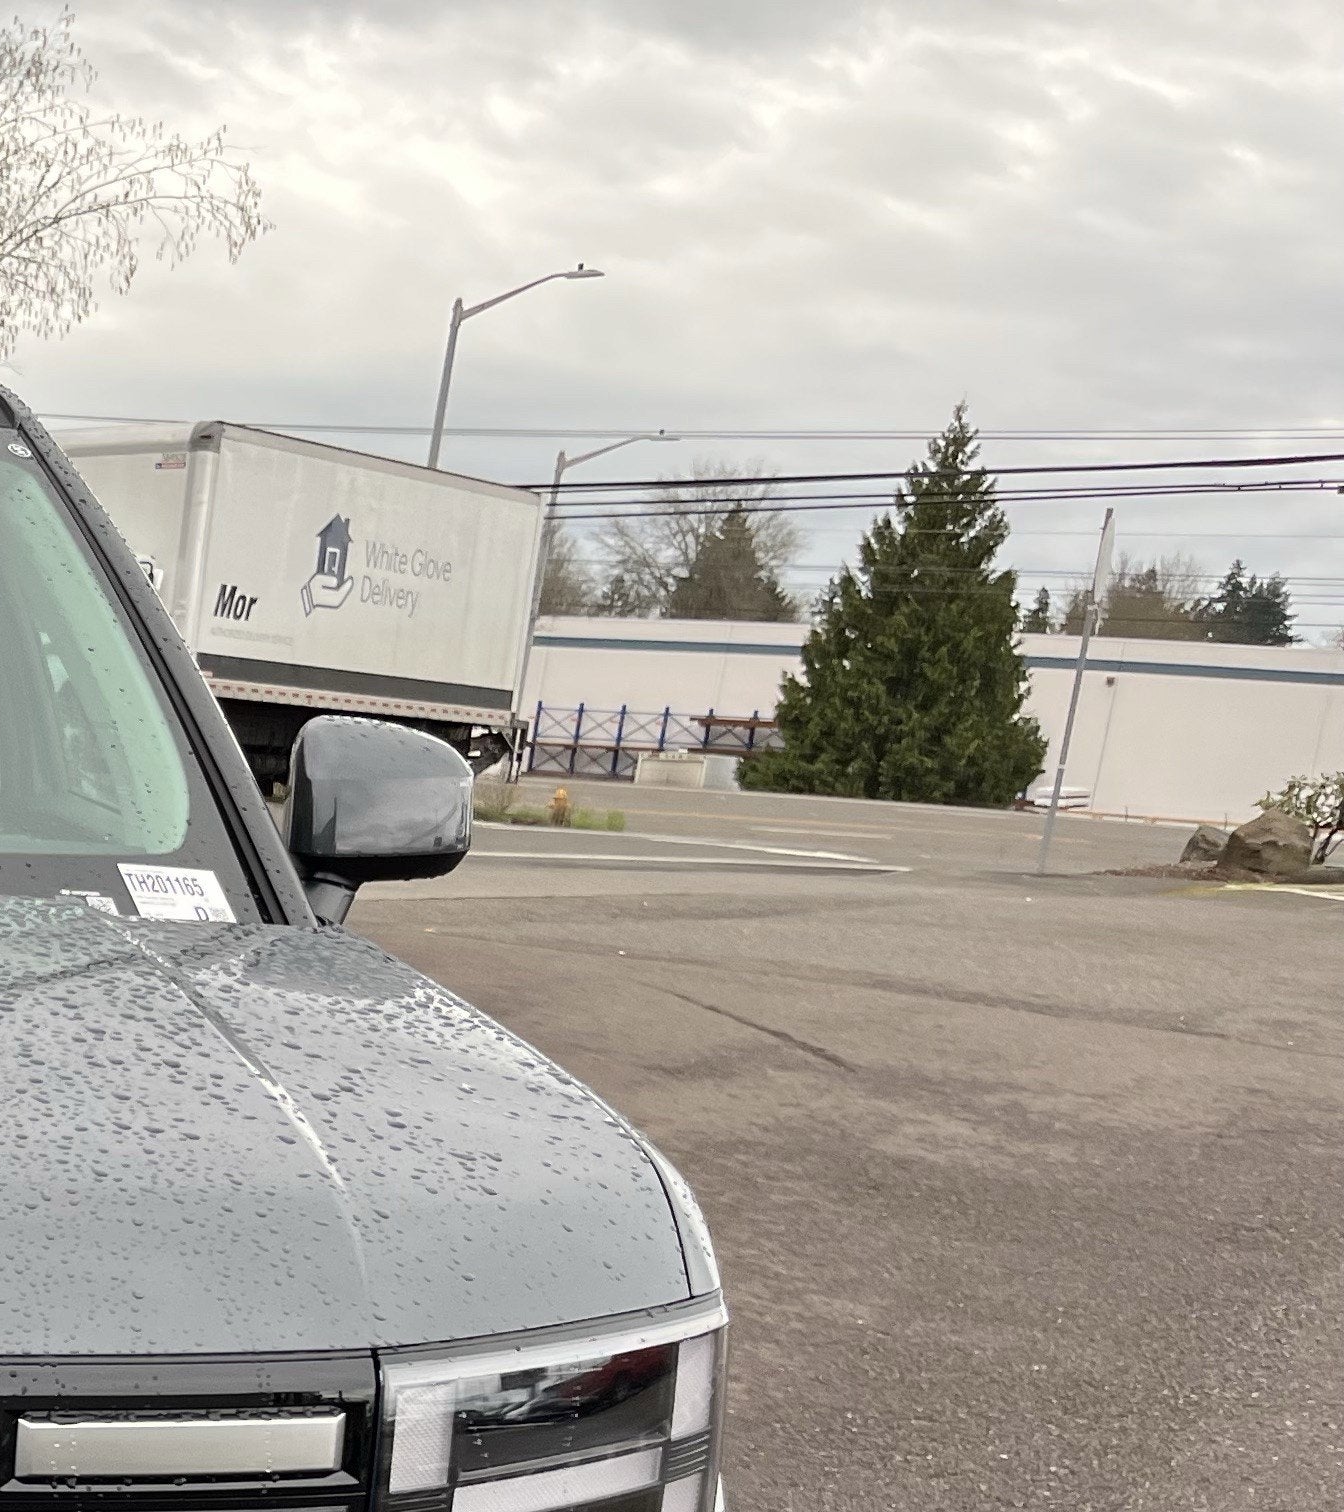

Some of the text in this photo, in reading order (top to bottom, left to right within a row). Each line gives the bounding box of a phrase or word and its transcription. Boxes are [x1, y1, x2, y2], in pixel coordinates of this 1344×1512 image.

[365, 540, 452, 582] White Glove
[214, 584, 258, 621] Mor
[360, 575, 421, 618] Delivery
[125, 872, 205, 897] TH201165
